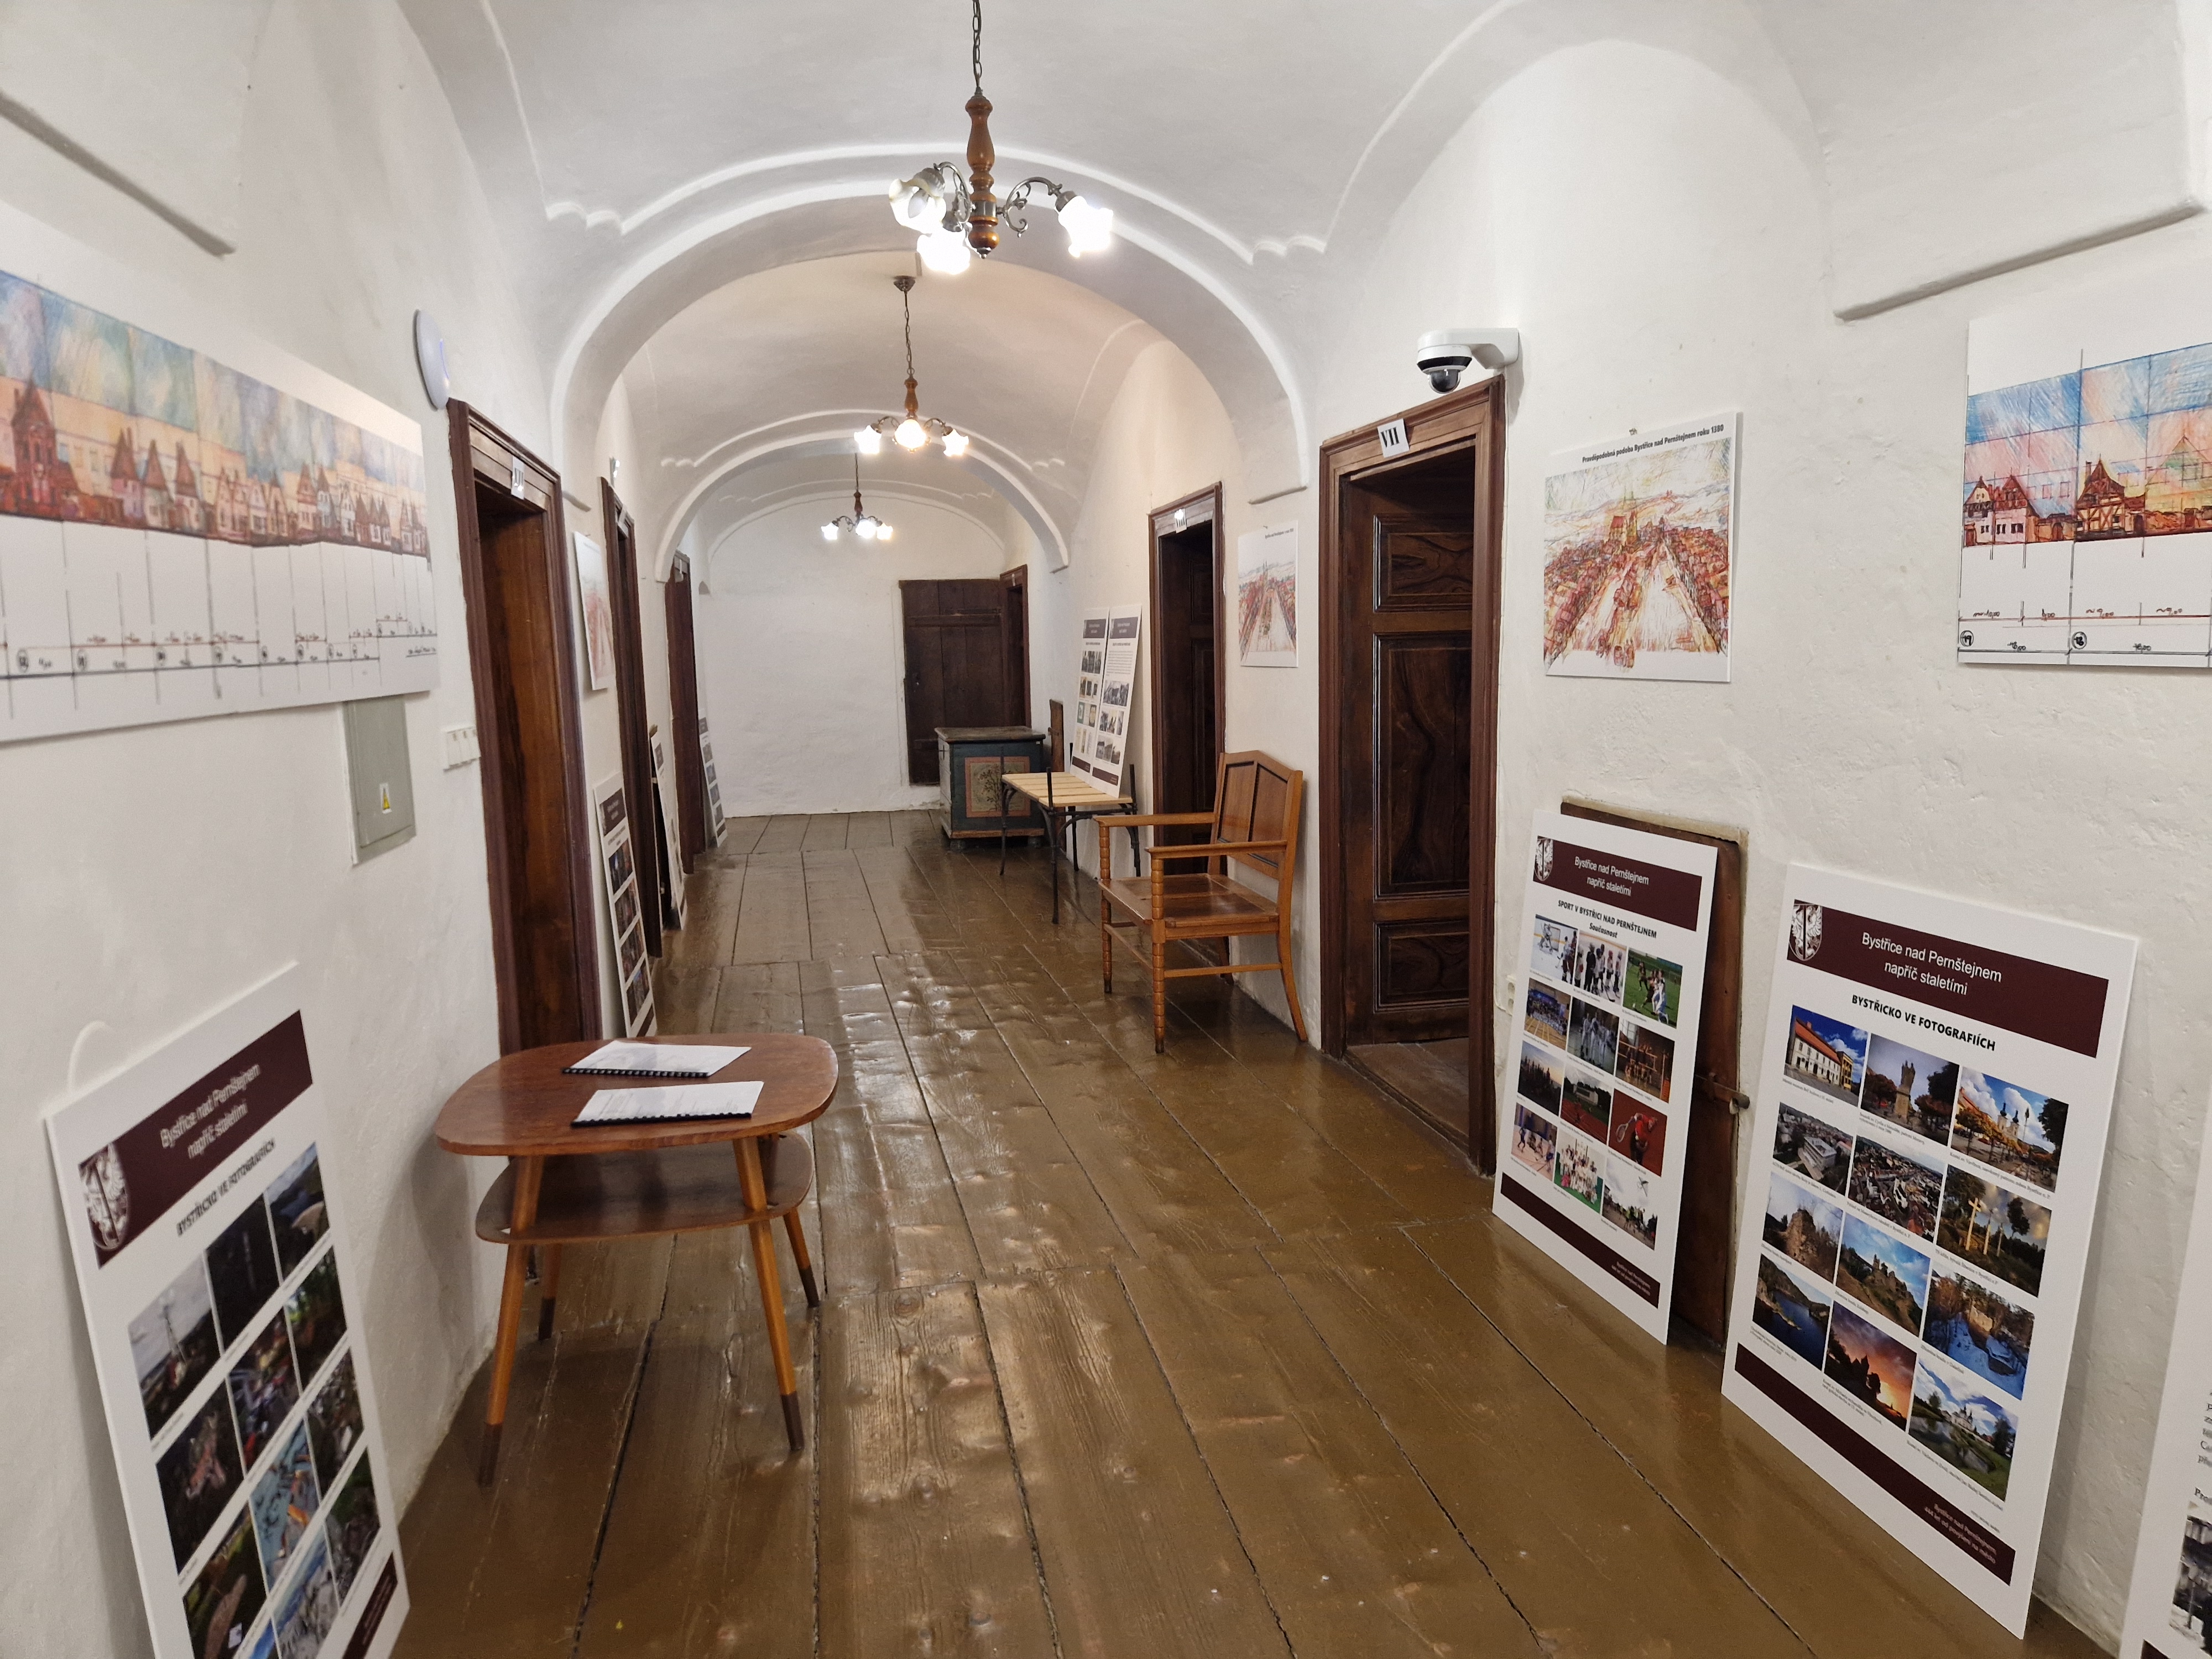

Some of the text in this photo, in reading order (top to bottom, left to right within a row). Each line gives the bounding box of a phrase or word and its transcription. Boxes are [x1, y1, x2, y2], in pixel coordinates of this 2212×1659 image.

[1380, 426, 1400, 447] VII
[1582, 424, 1724, 463] Pravděpodobná podoba Bystřice nad Pernštejnem roku 1380
[1574, 856, 1649, 885] Bystřice nad Pernštejnem
[1587, 877, 1631, 896] napříč staletími
[1558, 899, 1574, 911] SPORT
[1579, 907, 1602, 921] BYSTŘICI
[1603, 914, 1615, 925] NAD
[1616, 919, 1657, 938] PERNŠTEJNEM
[1589, 922, 1618, 938] Současnost
[1861, 932, 2002, 983] Bystřice nad Pernštejnem
[1884, 962, 1968, 995] napříč staletími
[1852, 994, 1996, 1051] BYSTŘICKO VE FOTOGRAFIÍCH
